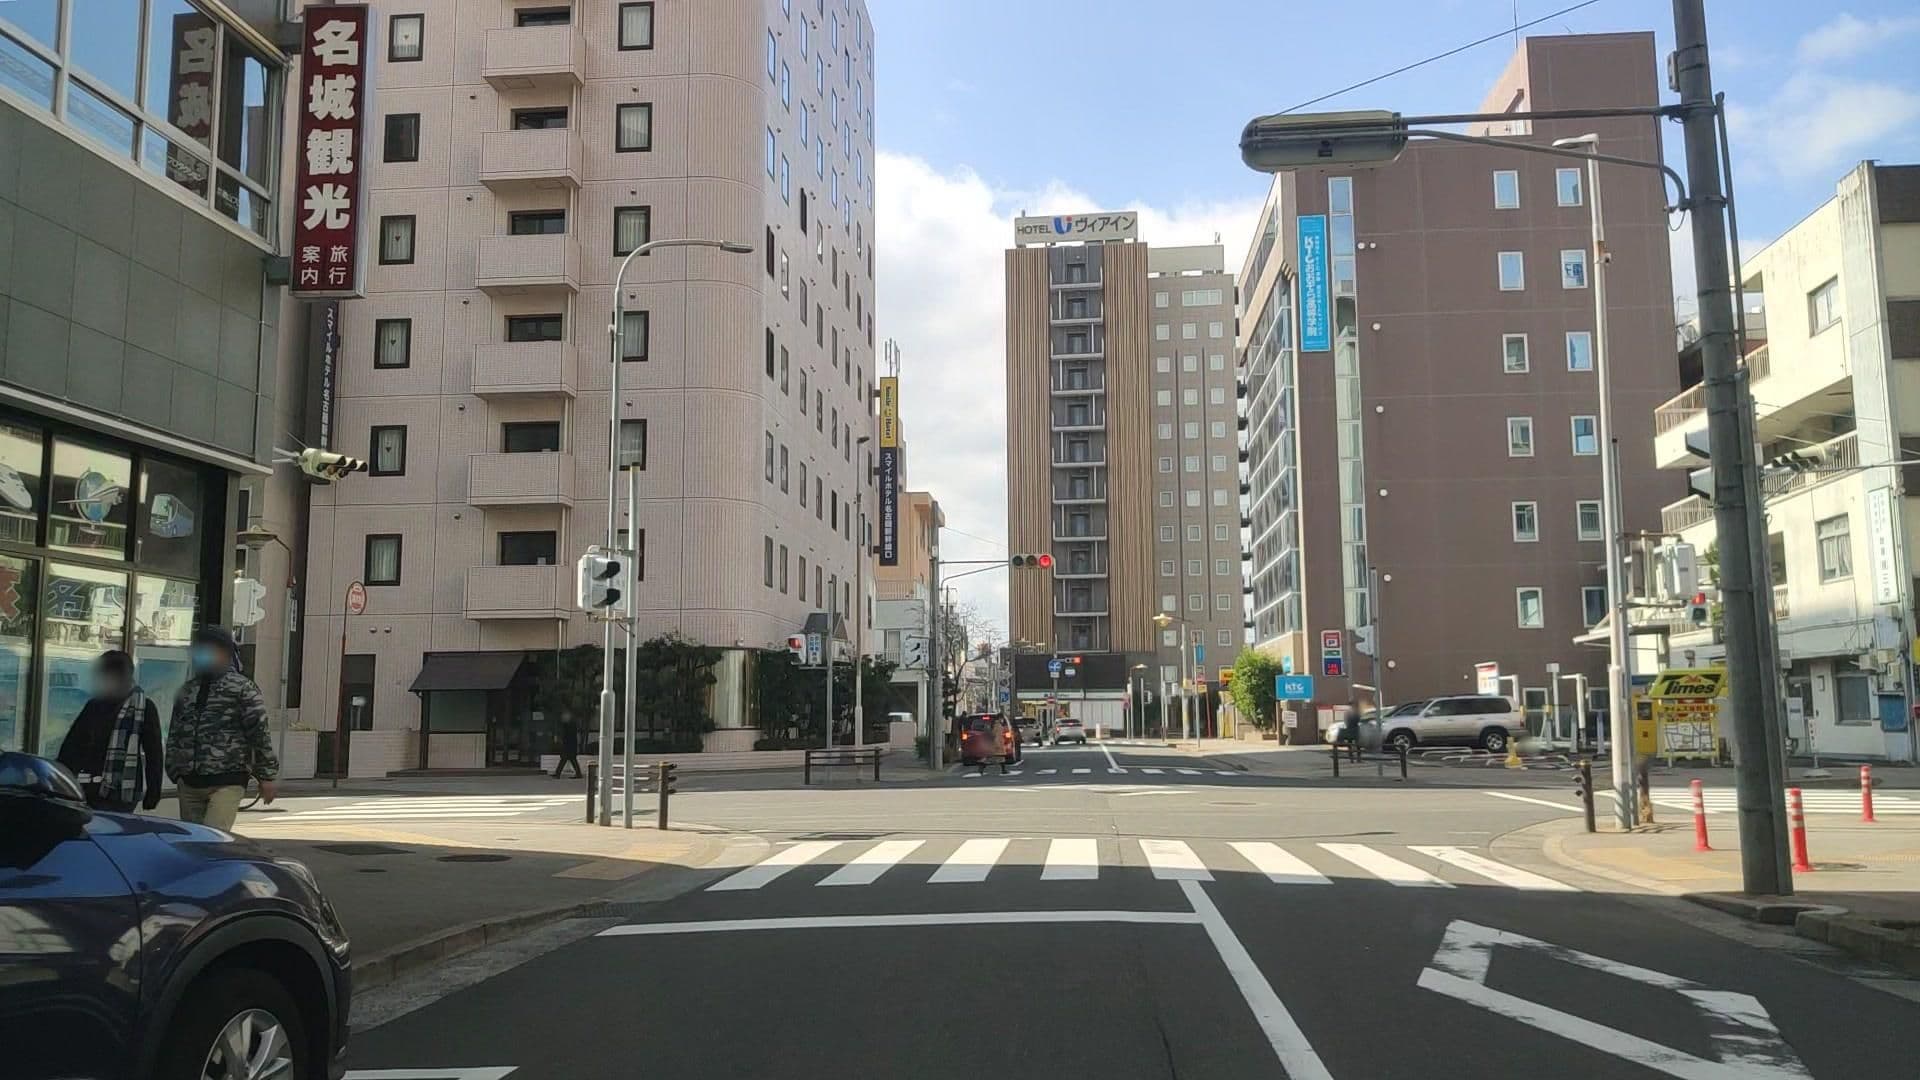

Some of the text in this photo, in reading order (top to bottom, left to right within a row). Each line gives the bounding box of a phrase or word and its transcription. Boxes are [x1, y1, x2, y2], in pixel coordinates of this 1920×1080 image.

[303, 20, 359, 230] 名城観光
[1017, 225, 1051, 234] HOTEL
[1075, 216, 1135, 233] ヴィアイン
[301, 245, 320, 285] 案内
[329, 245, 348, 284] 旅行
[1664, 680, 1715, 695] Times
